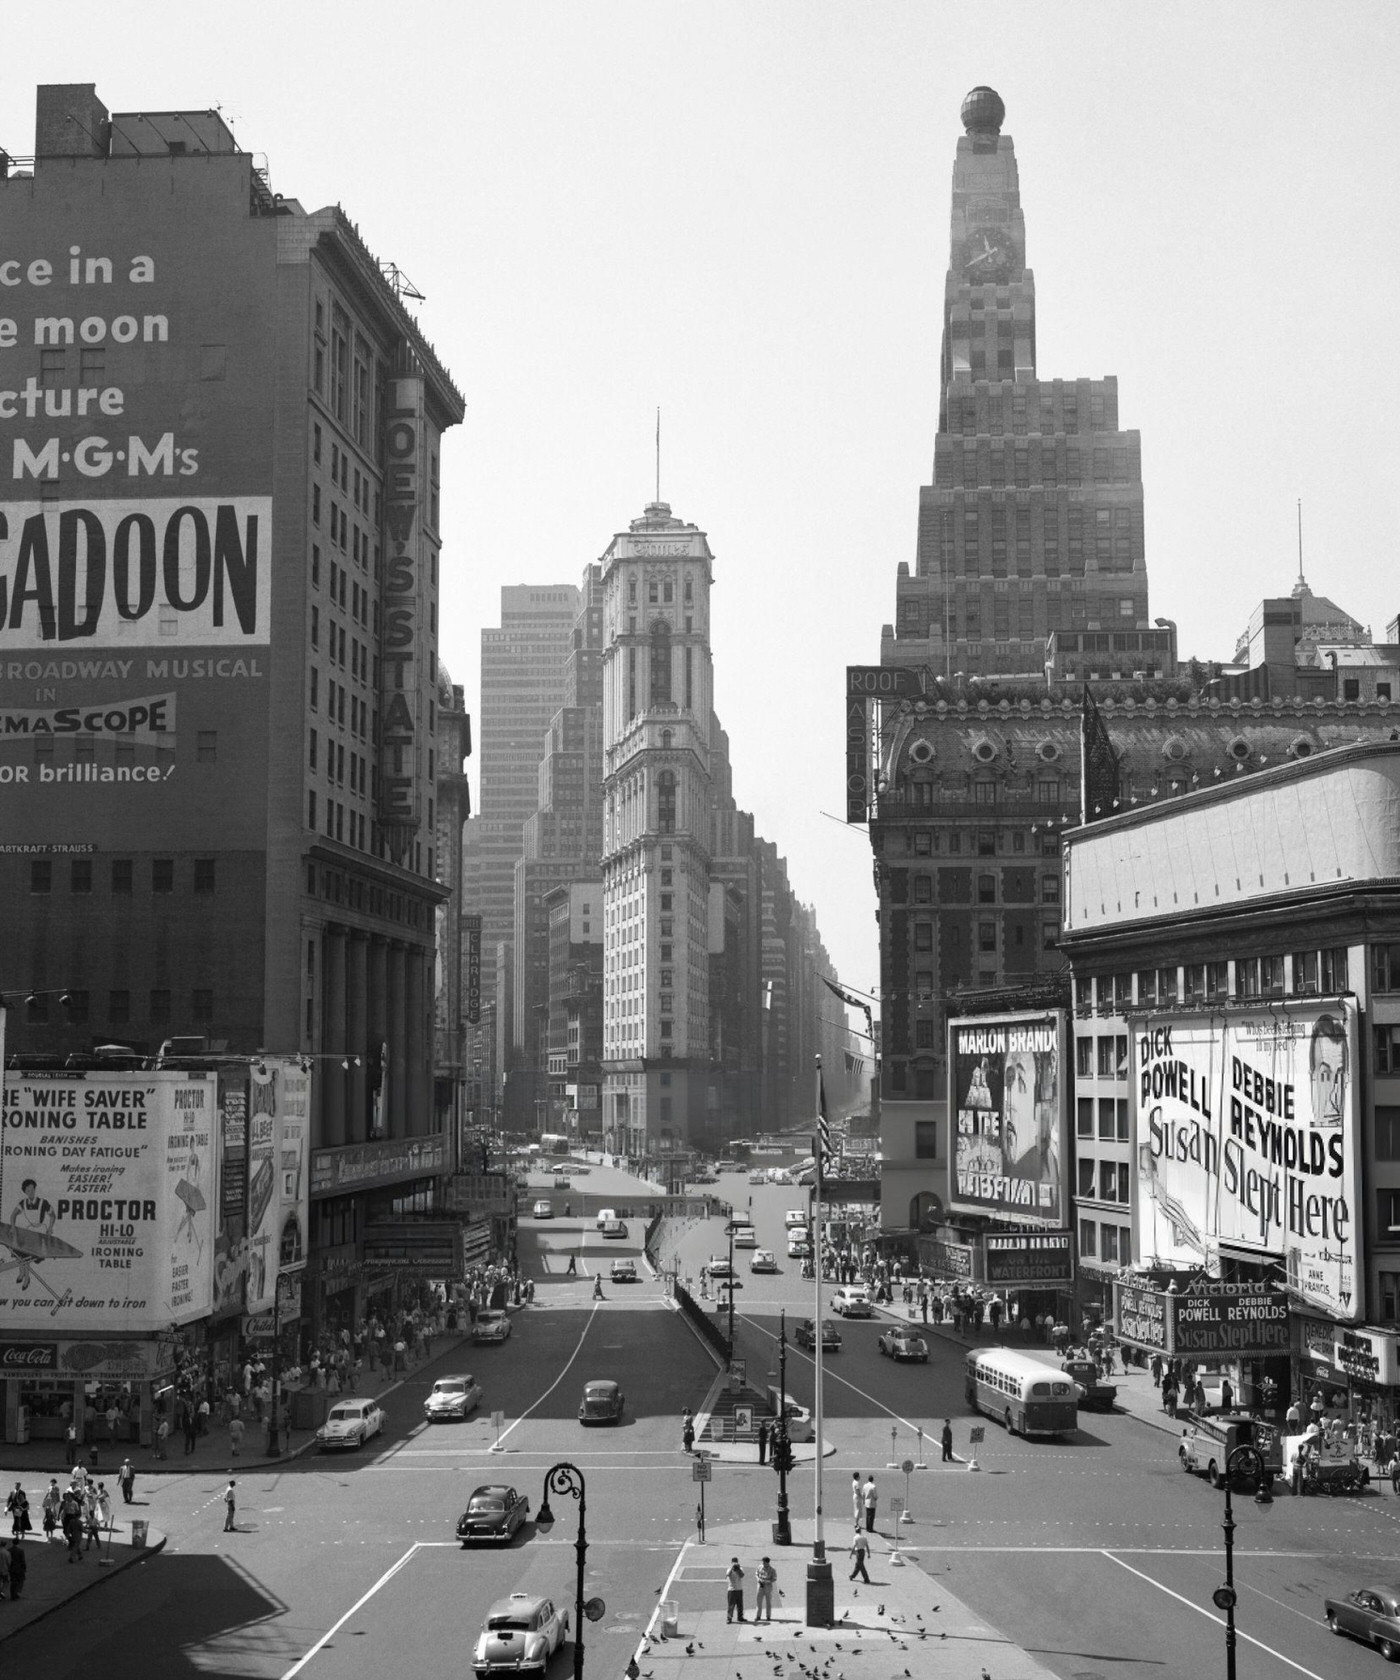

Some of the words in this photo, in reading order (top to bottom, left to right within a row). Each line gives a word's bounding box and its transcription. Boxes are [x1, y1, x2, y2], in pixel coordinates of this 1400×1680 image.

[69, 245, 113, 285] in
[128, 255, 155, 284] a
[34, 314, 169, 345] moon
[386, 380, 417, 593] LOEW'S
[0, 504, 259, 642] ADOON
[0, 660, 134, 681] ROADWAY
[146, 658, 263, 679] MUSICAL
[850, 671, 905, 691] ROOF
[36, 688, 57, 702] IN
[384, 608, 415, 816] STATE
[847, 702, 867, 818] ASTOR
[0, 765, 29, 783] OR
[40, 763, 176, 783] brilliance!
[470, 933, 480, 1020] CLARIDGE
[958, 1028, 1006, 1055] MARLON
[1141, 1025, 1174, 1068] DICK
[24, 1087, 76, 1107] "WIFE
[84, 1089, 156, 1108] SAVER"
[1141, 1060, 1211, 1122] POWELL
[1232, 1055, 1295, 1121] DEBBIE
[87, 1111, 147, 1129] TABLE
[40, 1135, 99, 1145] BANISHES
[1149, 1105, 1219, 1178] Susan
[1231, 1094, 1345, 1179] REYNOLDS
[62, 1147, 87, 1158] DAY
[90, 1145, 149, 1158] FATIGUE"
[60, 1163, 91, 1174] Makes
[92, 1163, 126, 1177] ironing
[68, 1173, 113, 1184] EASIER!
[66, 1183, 113, 1194] FASTER!
[1224, 1138, 1282, 1238] Slept
[1288, 1175, 1350, 1244] Here
[57, 1199, 157, 1221] PROCTOR
[99, 1223, 135, 1238] HI-LO
[98, 1238, 137, 1246] ADJUSTABLE
[91, 1247, 145, 1258] IRONING
[98, 1258, 133, 1269] TABLE
[991, 1265, 1067, 1279] WATERFRONT
[1189, 1279, 1266, 1296] Victoria
[12, 1299, 31, 1310] you
[33, 1299, 54, 1308] can
[57, 1296, 73, 1308] sit
[75, 1296, 103, 1309] down
[108, 1297, 120, 1308] to
[122, 1297, 147, 1309] iron
[1187, 1299, 1211, 1308] DICK
[1238, 1297, 1273, 1307] DEBBIE
[1178, 1308, 1222, 1322] POWELL
[1227, 1306, 1288, 1321] REYNOLDS
[1177, 1323, 1218, 1350] Susan
[1219, 1321, 1255, 1349] Slept
[1255, 1319, 1289, 1346] Here
